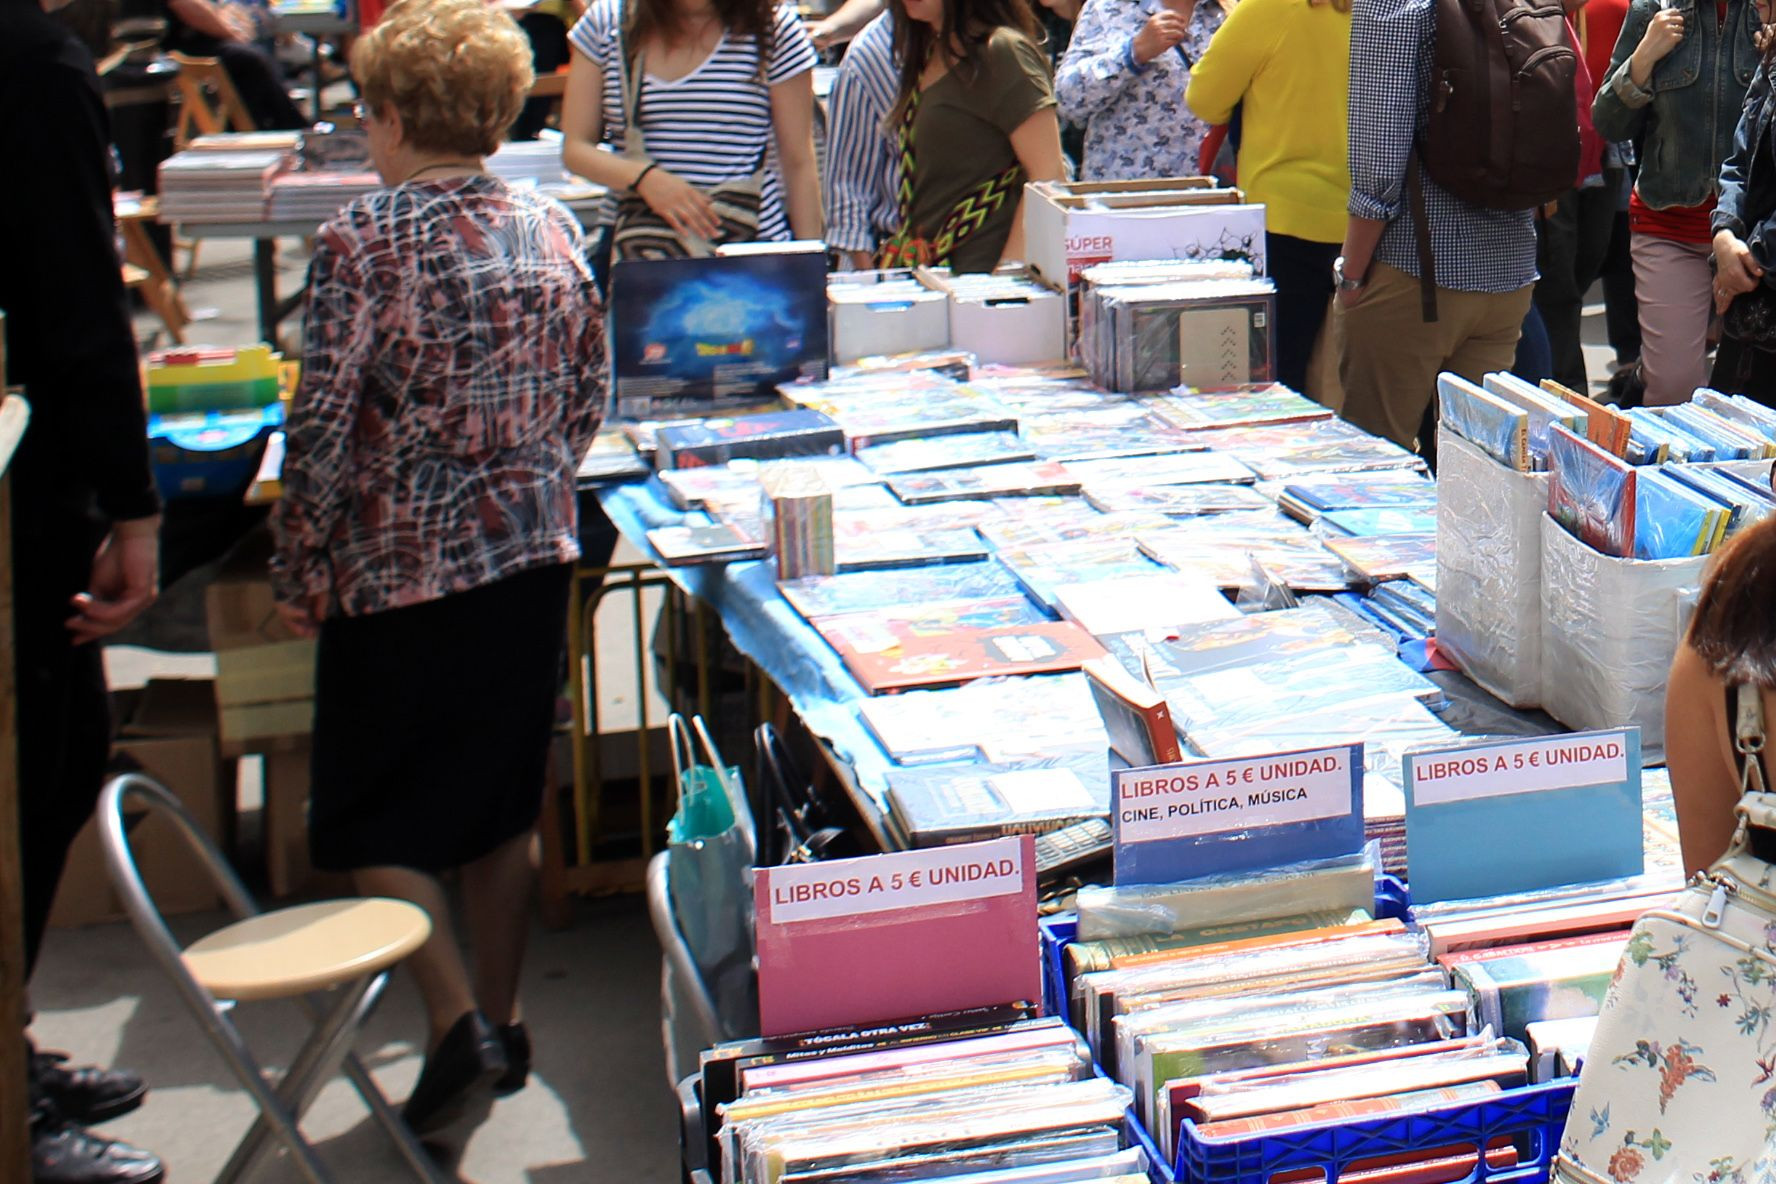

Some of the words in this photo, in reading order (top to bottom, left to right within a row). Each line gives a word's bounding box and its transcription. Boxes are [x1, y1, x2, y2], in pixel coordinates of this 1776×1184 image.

[1120, 772, 1201, 801] LIBROS
[1205, 770, 1222, 788] A
[1226, 768, 1237, 785] 5
[1241, 766, 1255, 783] €
[1258, 756, 1343, 782] UNIDAD.
[1416, 757, 1489, 782] LIBROS
[1494, 755, 1508, 772] A
[1513, 753, 1524, 770] 5
[1528, 751, 1541, 767] €
[1545, 742, 1625, 767] UNIDAD.
[1121, 806, 1163, 825] CINE,
[1167, 796, 1243, 819] POLÍTICA,
[1247, 785, 1308, 806] MÚSICA
[774, 876, 862, 906] LIBROS
[867, 874, 885, 895] A
[890, 873, 904, 890] 5
[908, 871, 922, 888] €
[928, 857, 1021, 886] UNIDAD.
